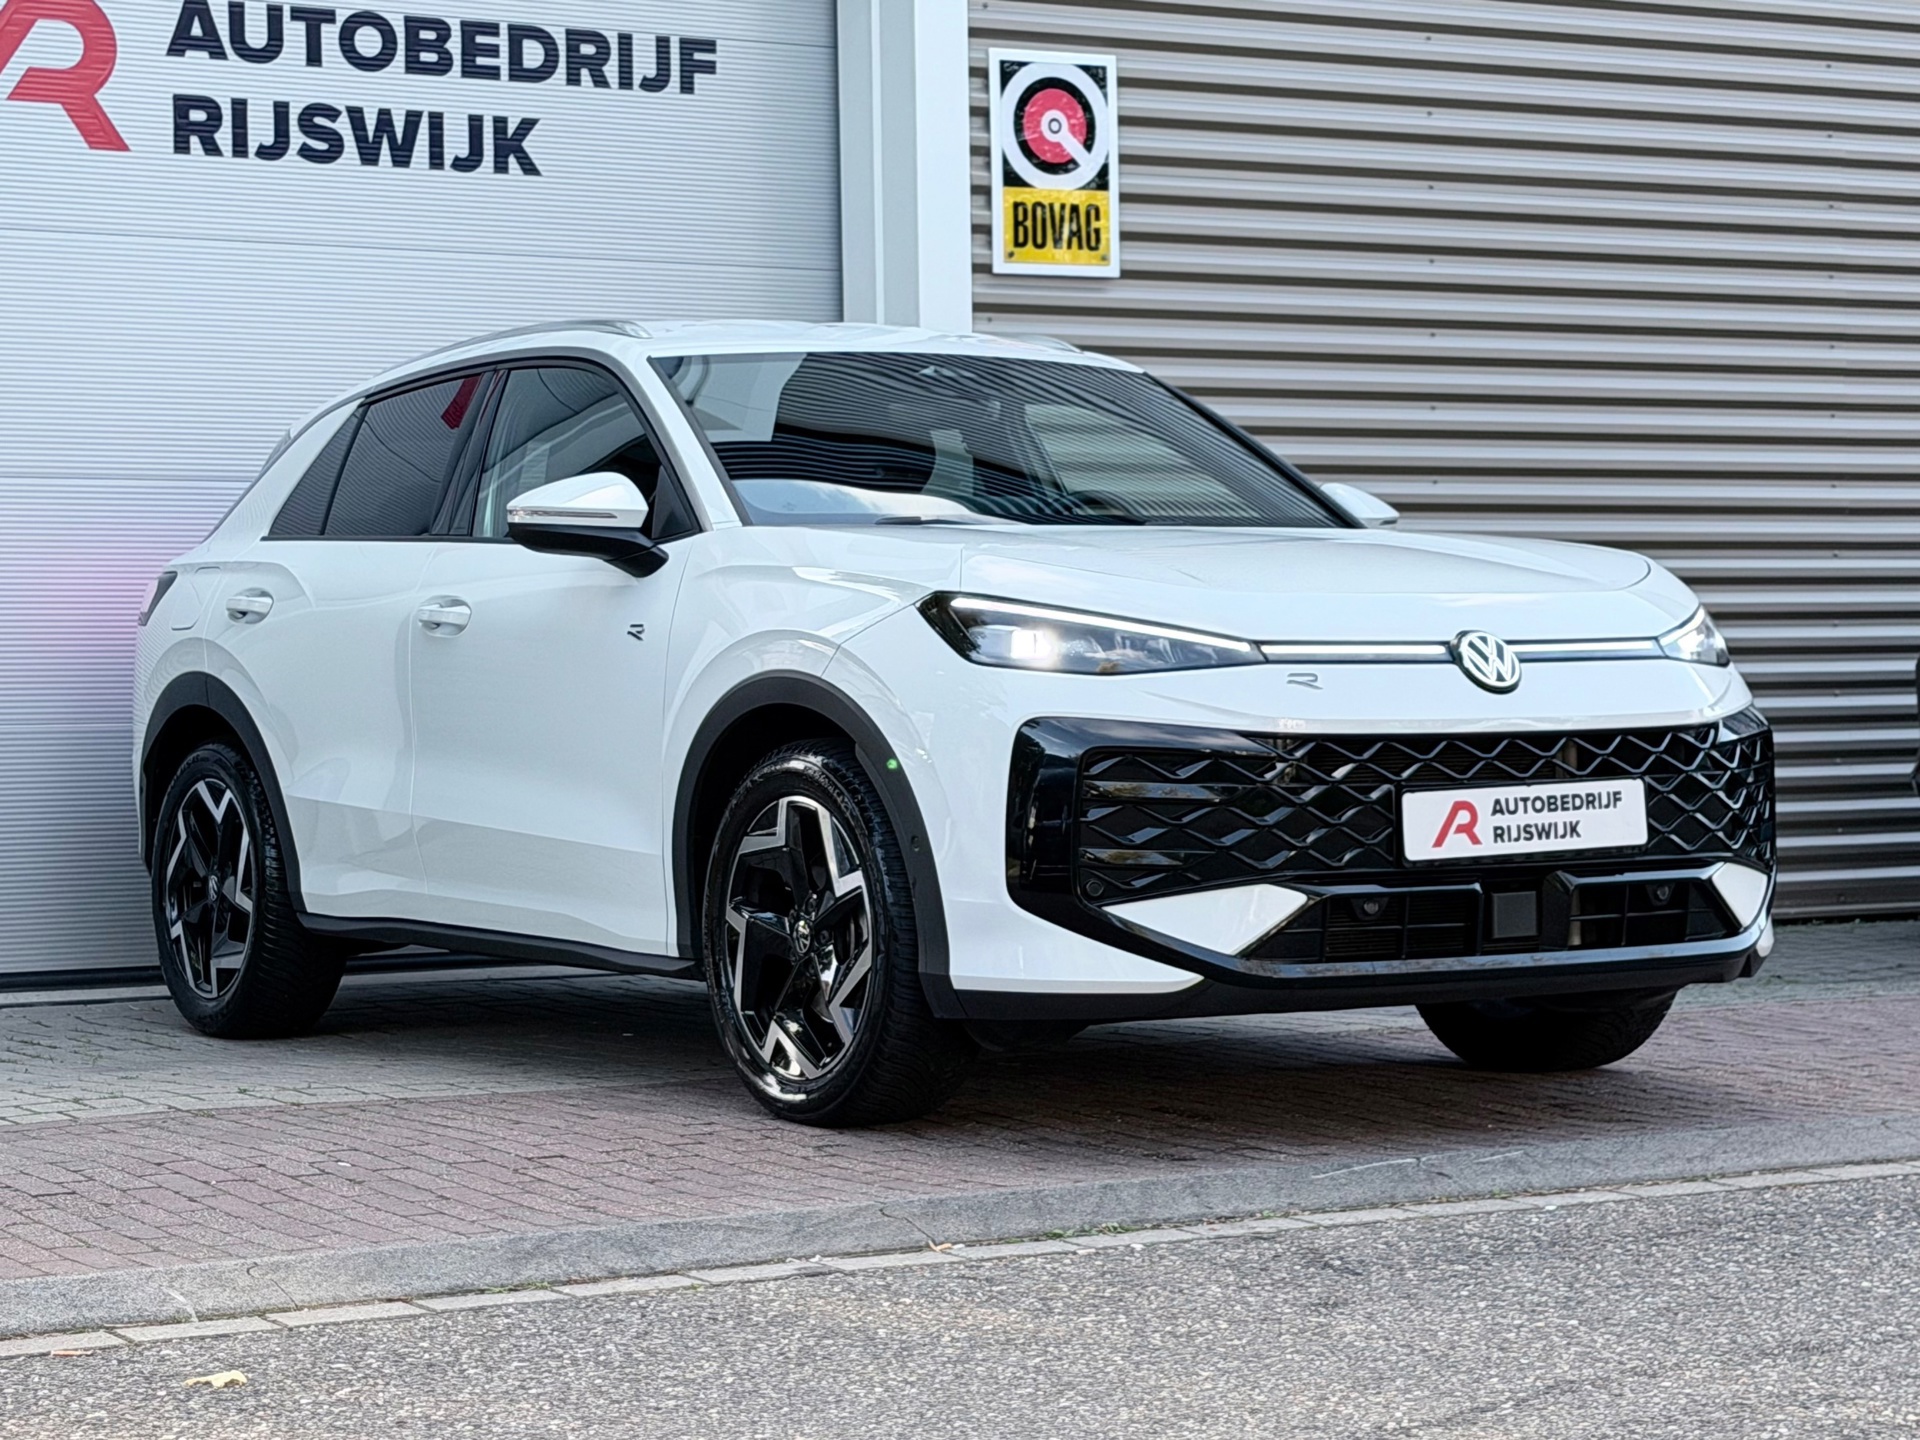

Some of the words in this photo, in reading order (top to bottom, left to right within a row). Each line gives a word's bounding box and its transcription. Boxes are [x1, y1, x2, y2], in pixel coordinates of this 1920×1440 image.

[166, 0, 718, 95] AUTOBEDRIJF
[172, 94, 543, 177] RIJSWIJK
[1013, 201, 1101, 251] BOVAG
[1286, 672, 1323, 690] R
[1490, 791, 1622, 816] AUTOBEDRIJF
[1493, 820, 1581, 843] RIJSWIJK
